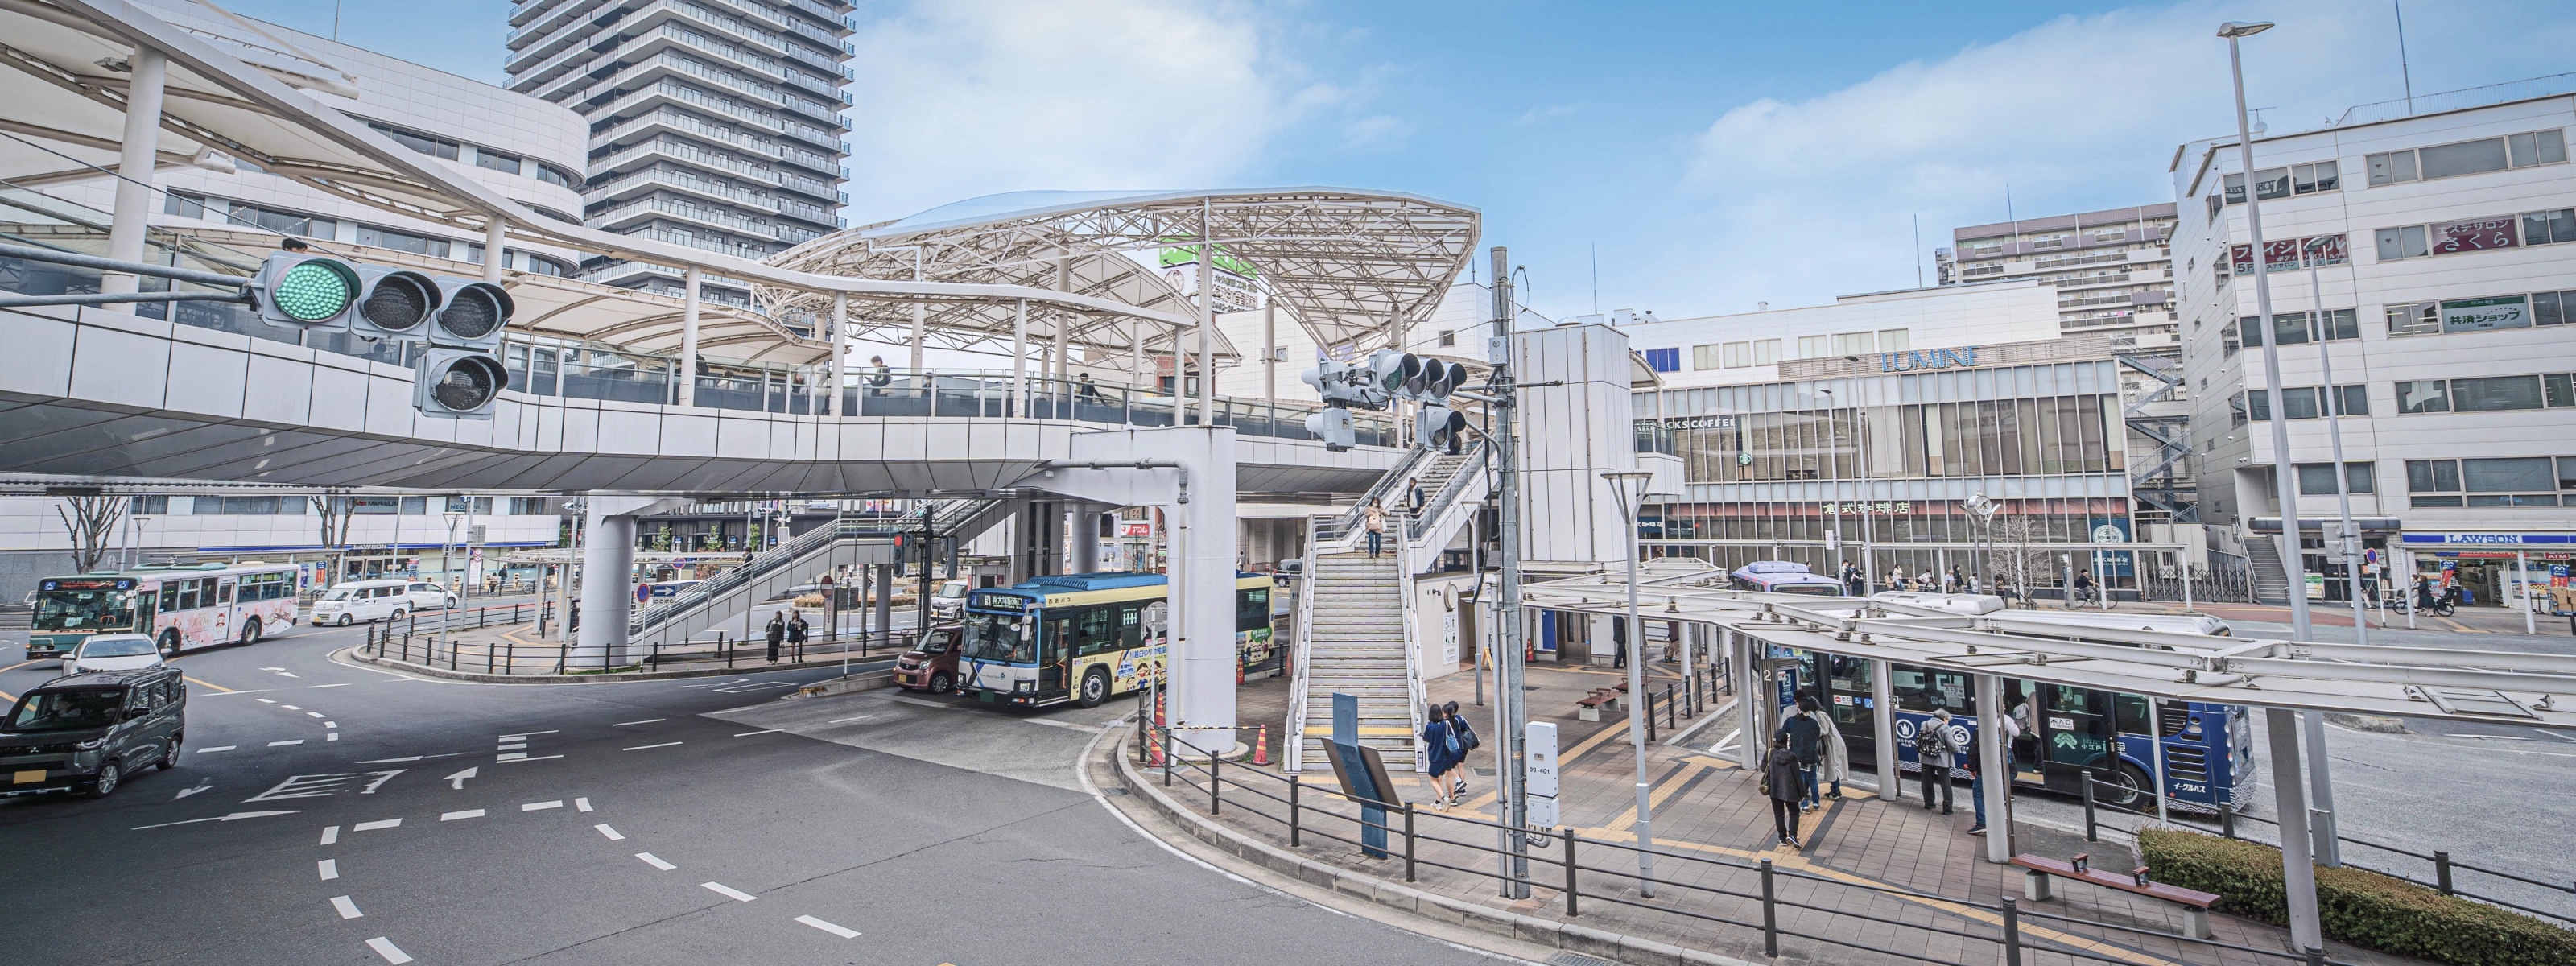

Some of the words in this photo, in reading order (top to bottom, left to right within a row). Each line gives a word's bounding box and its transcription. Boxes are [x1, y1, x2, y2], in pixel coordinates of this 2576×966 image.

[2437, 221, 2508, 234] エステサロン
[2440, 232, 2508, 251] さくら
[2238, 263, 2253, 272] 5F
[2266, 262, 2296, 270] ステサロン
[2450, 310, 2521, 325] 共済ショップ
[1881, 345, 1981, 372] LUMINE
[1691, 418, 1736, 428] COFFEE
[1823, 502, 1909, 514] 倉式珈琲店
[2449, 535, 2518, 543] LAWSON
[1763, 669, 1771, 681] 2
[1784, 675, 1790, 687] 2
[2174, 782, 2206, 793] イーグルバス
